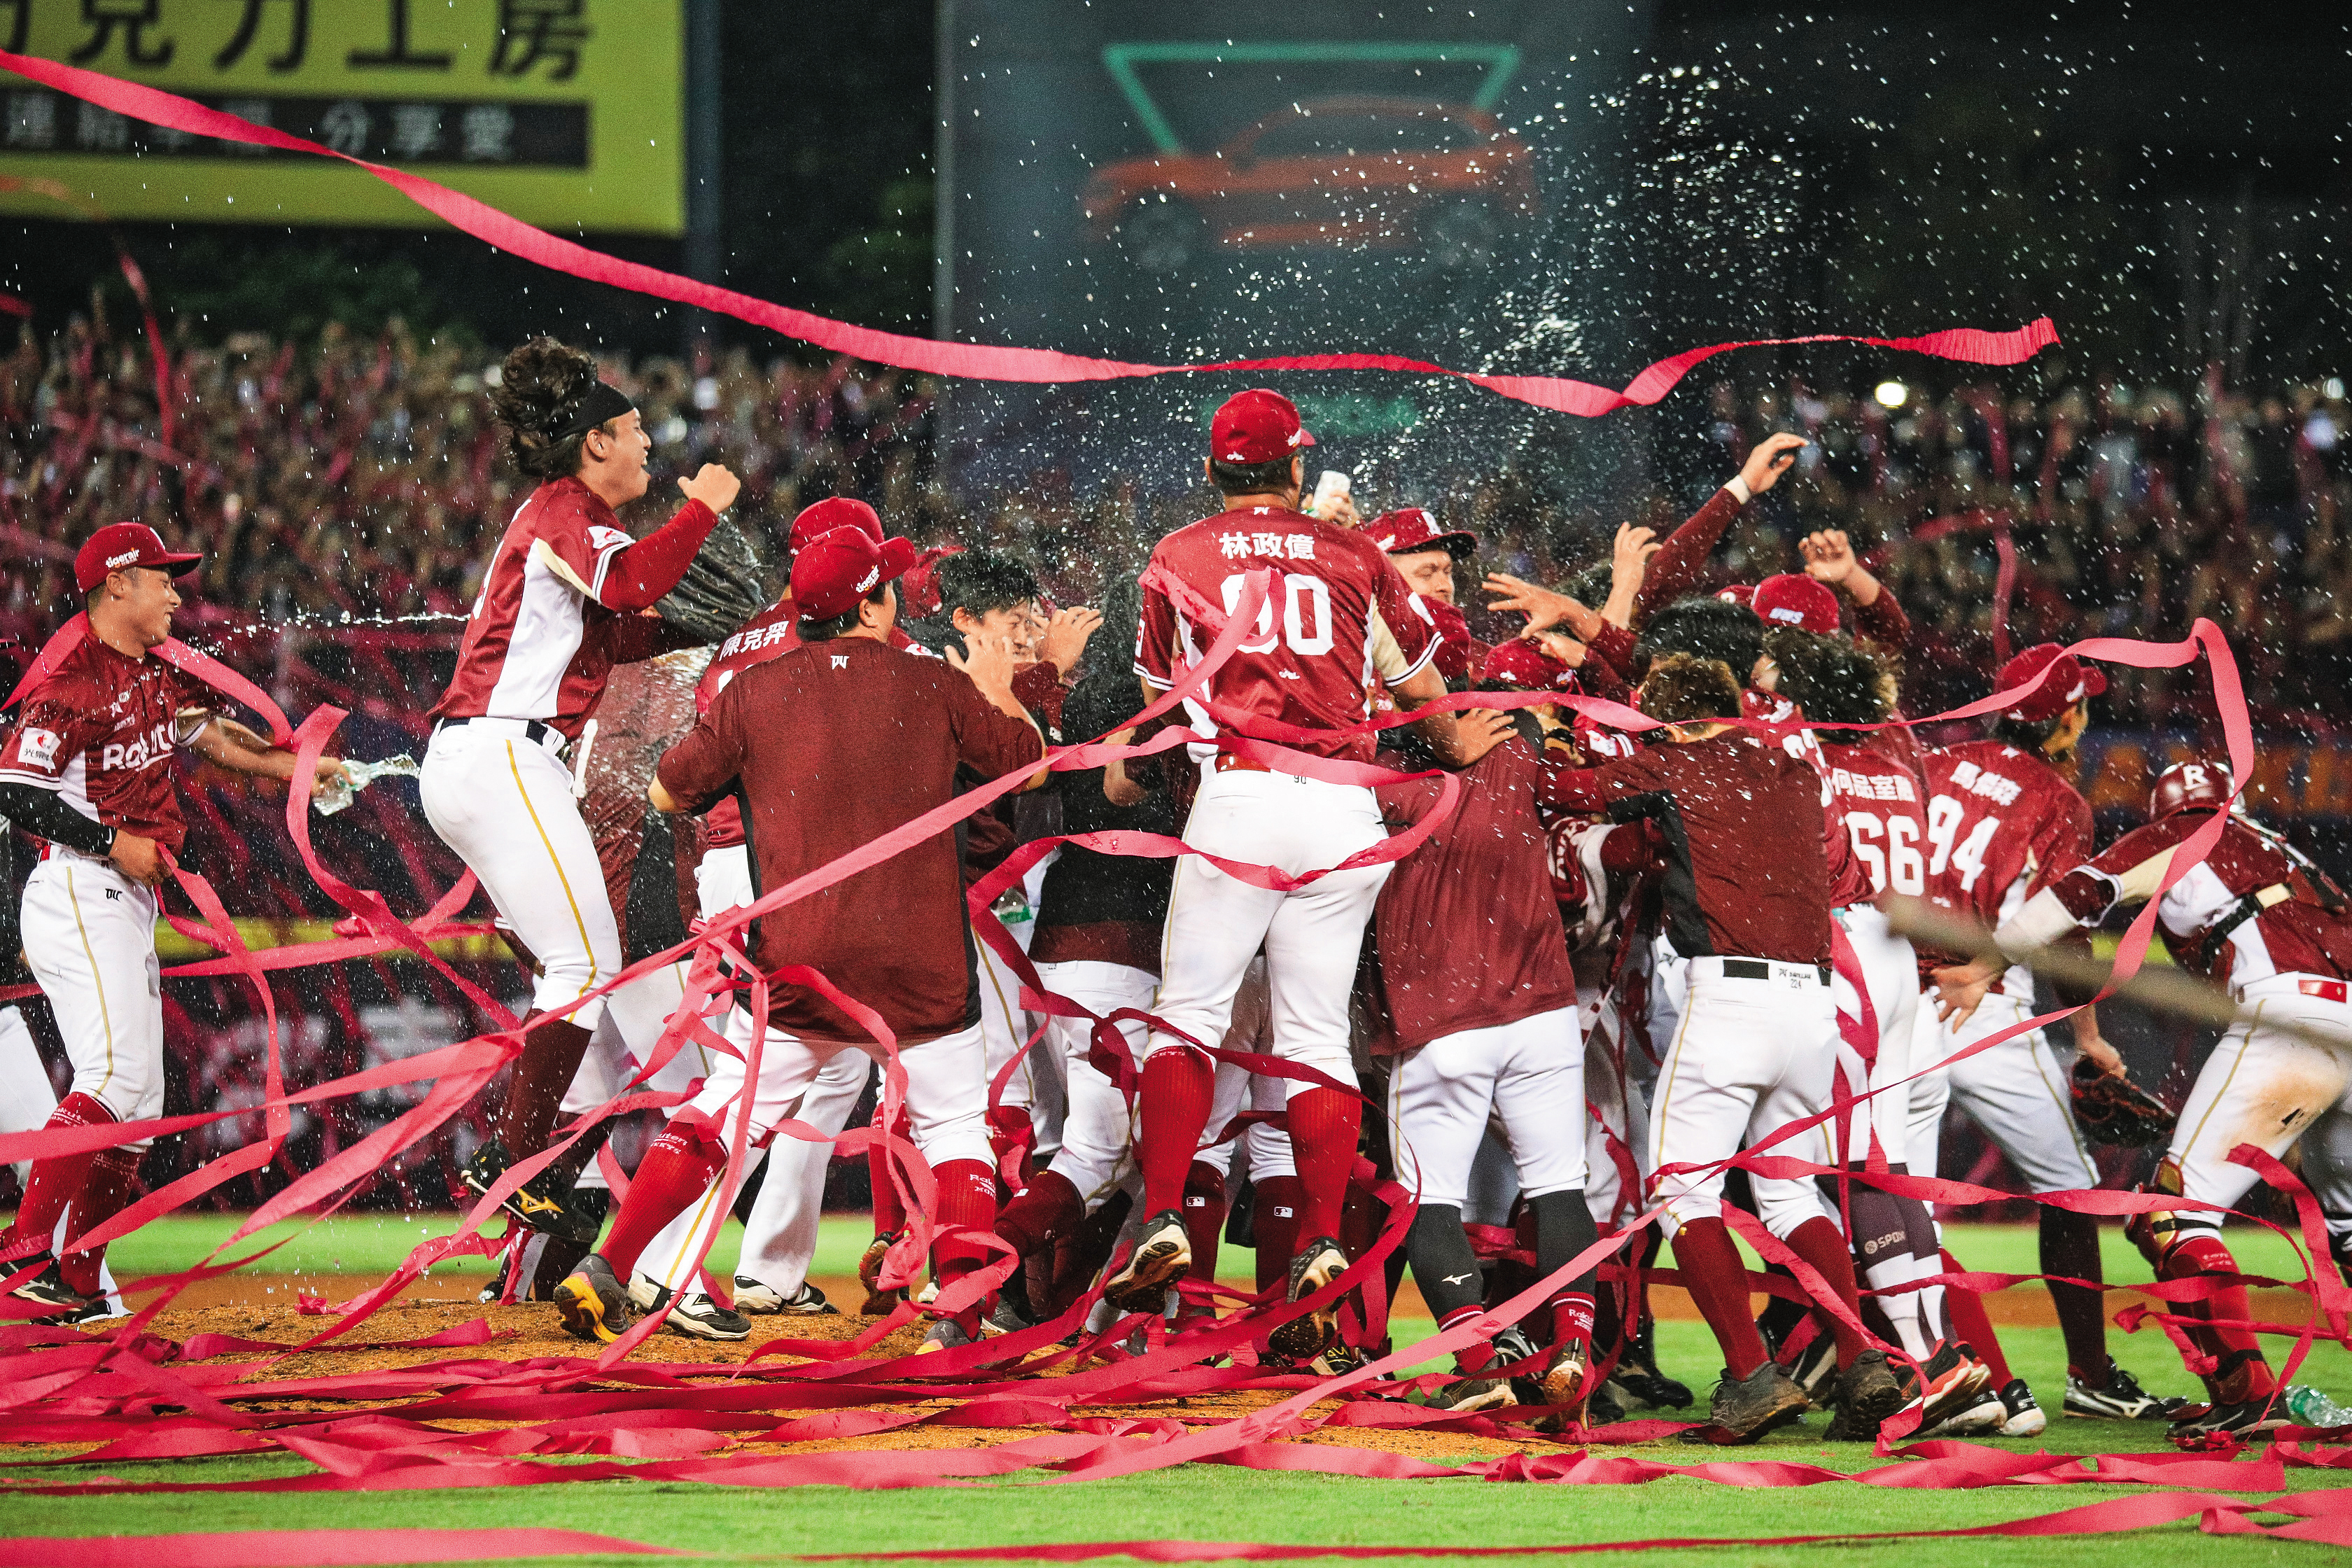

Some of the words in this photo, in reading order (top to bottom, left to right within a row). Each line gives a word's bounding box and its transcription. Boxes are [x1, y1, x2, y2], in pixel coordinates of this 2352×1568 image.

[1219, 532, 1316, 560] 林政億
[718, 621, 790, 662] 陳克羿
[2182, 764, 2208, 790] R
[1927, 794, 2000, 893] 94
